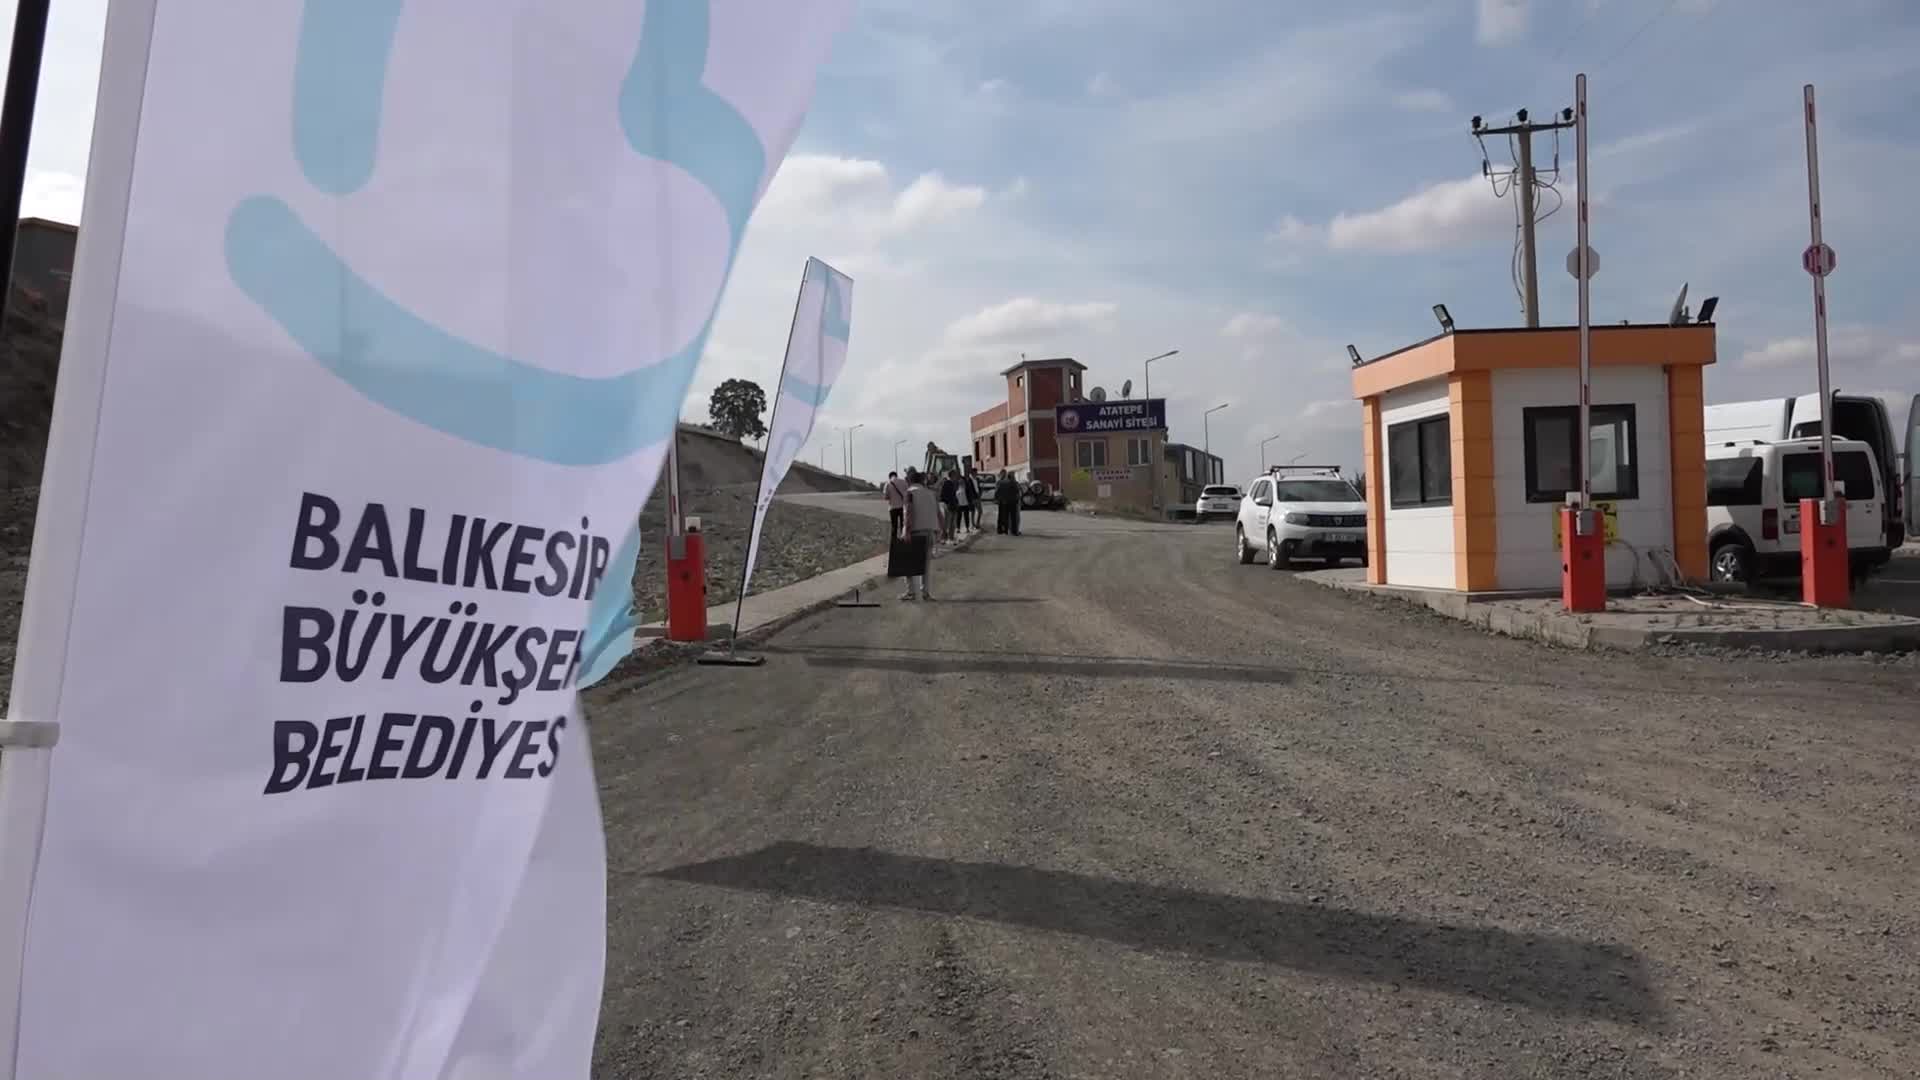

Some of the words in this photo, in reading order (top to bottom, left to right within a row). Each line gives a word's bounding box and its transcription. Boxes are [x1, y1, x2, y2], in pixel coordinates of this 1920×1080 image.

[1086, 417, 1123, 430] SANAYİ
[1125, 416, 1157, 428] SİTESİ
[1099, 405, 1143, 416] ATATEPE
[290, 491, 610, 601] BALIKESİR
[263, 699, 567, 796] BELEDİYES
